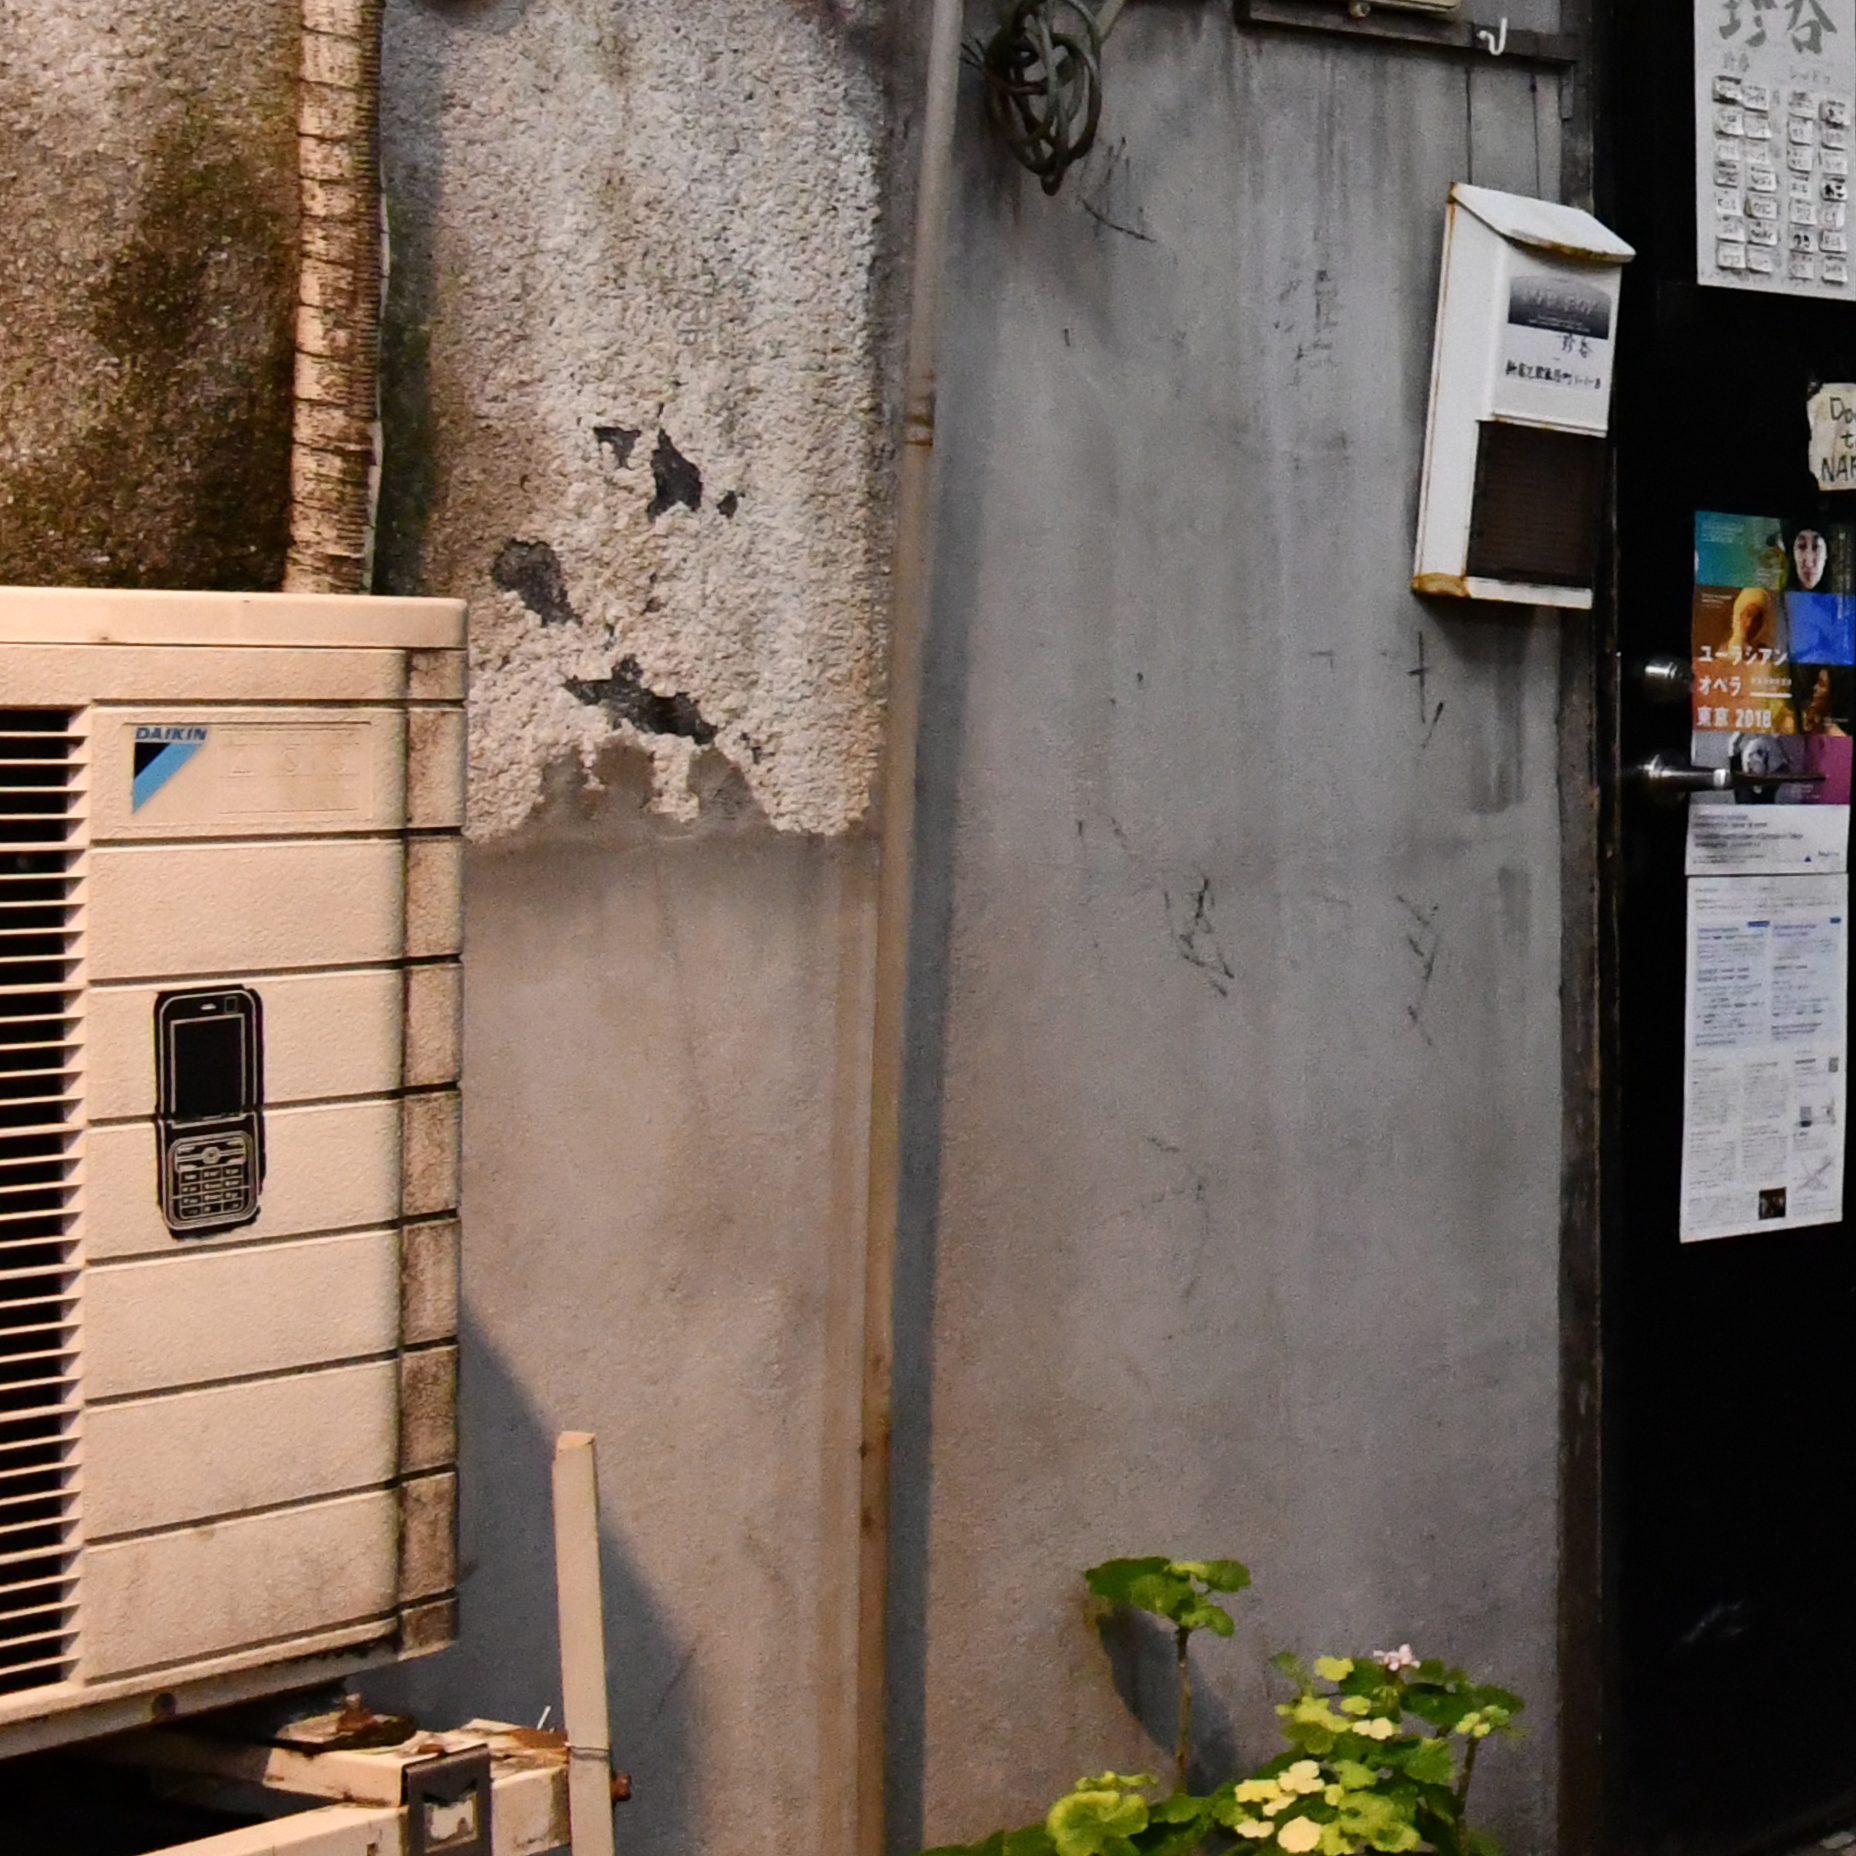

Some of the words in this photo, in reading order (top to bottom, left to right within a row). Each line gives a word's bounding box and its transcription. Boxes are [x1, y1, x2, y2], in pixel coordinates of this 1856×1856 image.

[1699, 645, 1789, 667] ユーラシアン
[1735, 708, 1773, 729] 2018
[135, 727, 208, 741] DAIKIN
